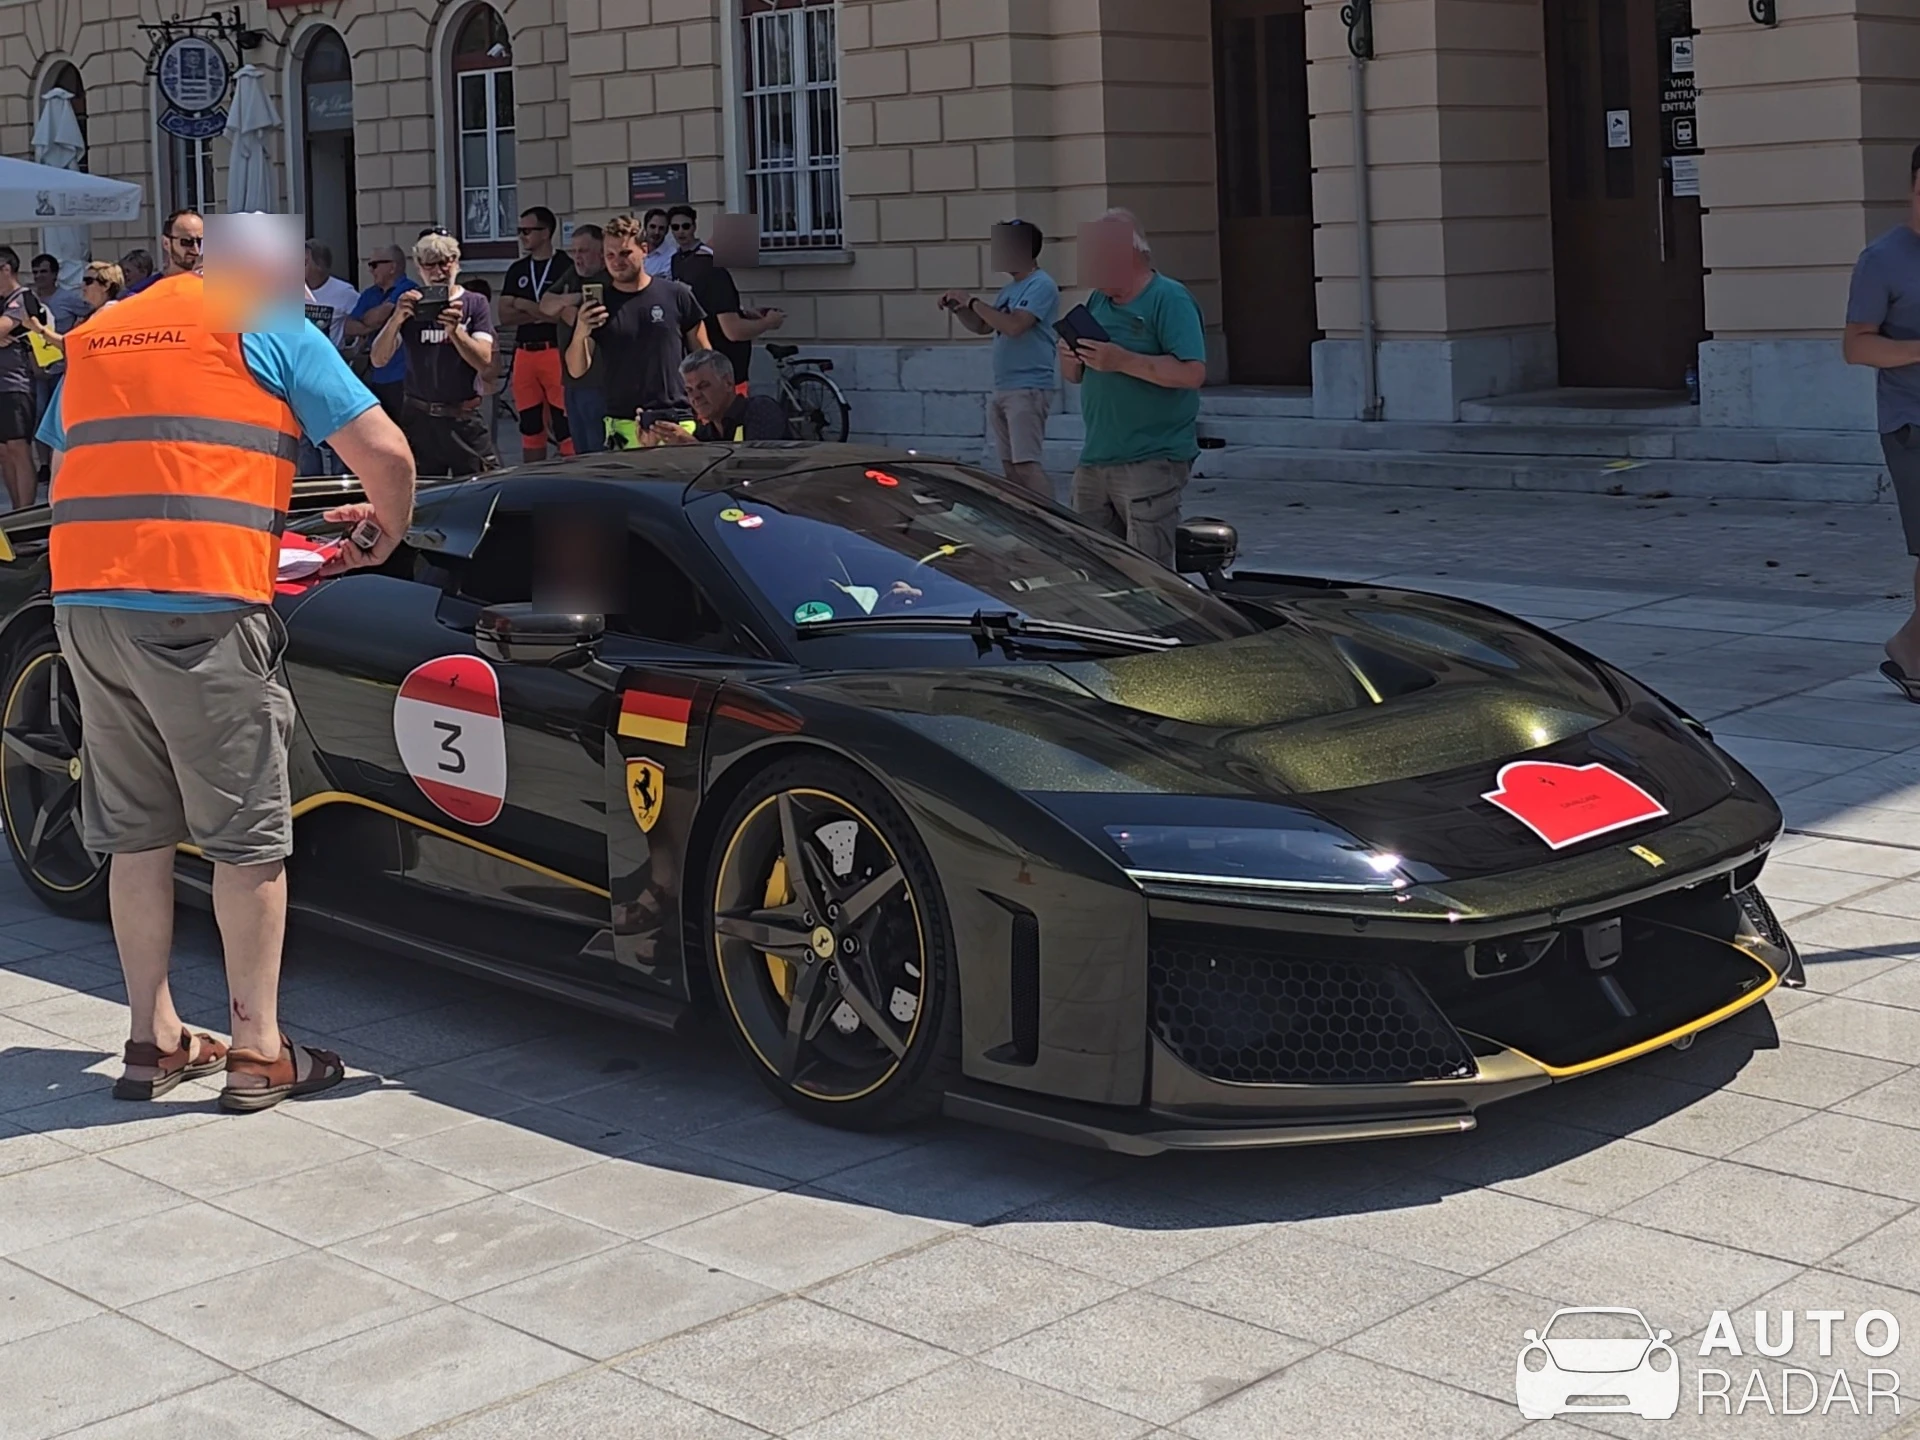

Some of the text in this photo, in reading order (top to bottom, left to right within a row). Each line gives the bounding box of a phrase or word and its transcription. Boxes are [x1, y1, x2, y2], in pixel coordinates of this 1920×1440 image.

[1670, 78, 1692, 88] VHO
[88, 330, 187, 351] MARSHAL
[433, 720, 466, 774] 3
